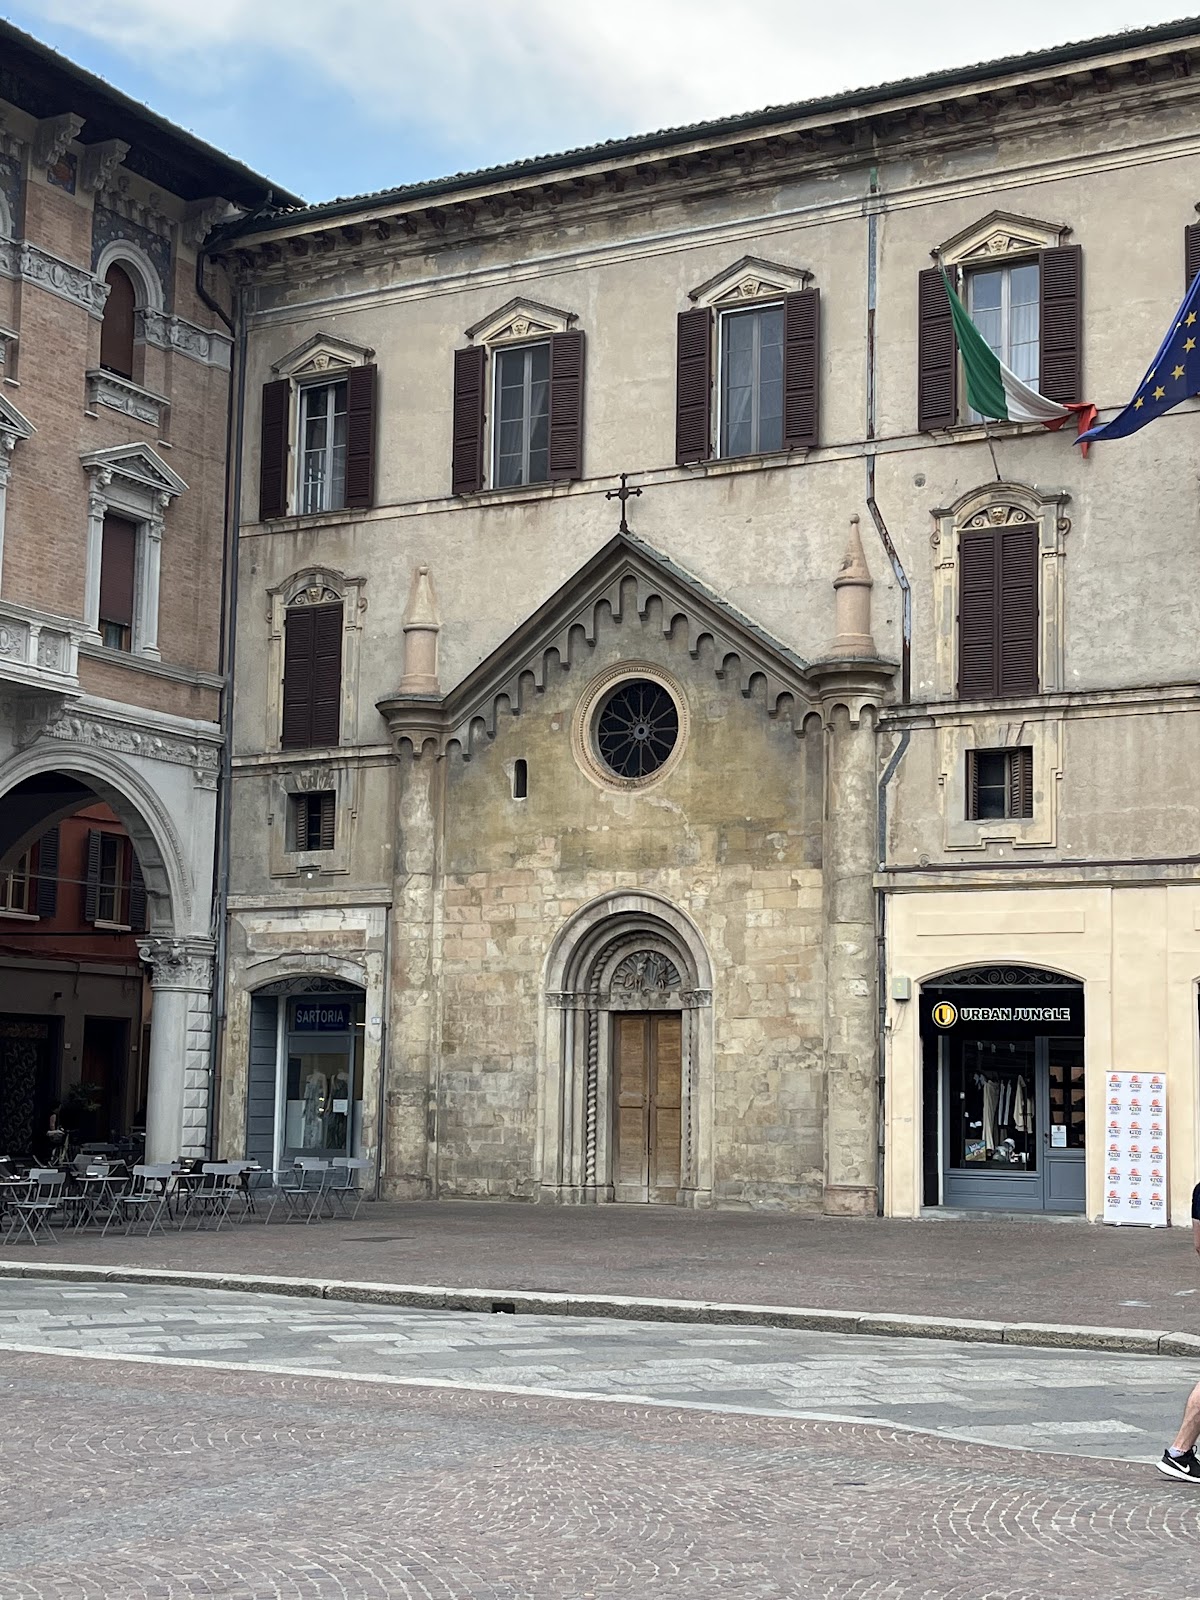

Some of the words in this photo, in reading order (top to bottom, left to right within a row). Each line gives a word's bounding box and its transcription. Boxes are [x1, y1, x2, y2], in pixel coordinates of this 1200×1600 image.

[296, 1010, 344, 1023] SARTORIA
[960, 1008, 1012, 1021] URBAN
[1013, 1008, 1071, 1021] JUNGLE
